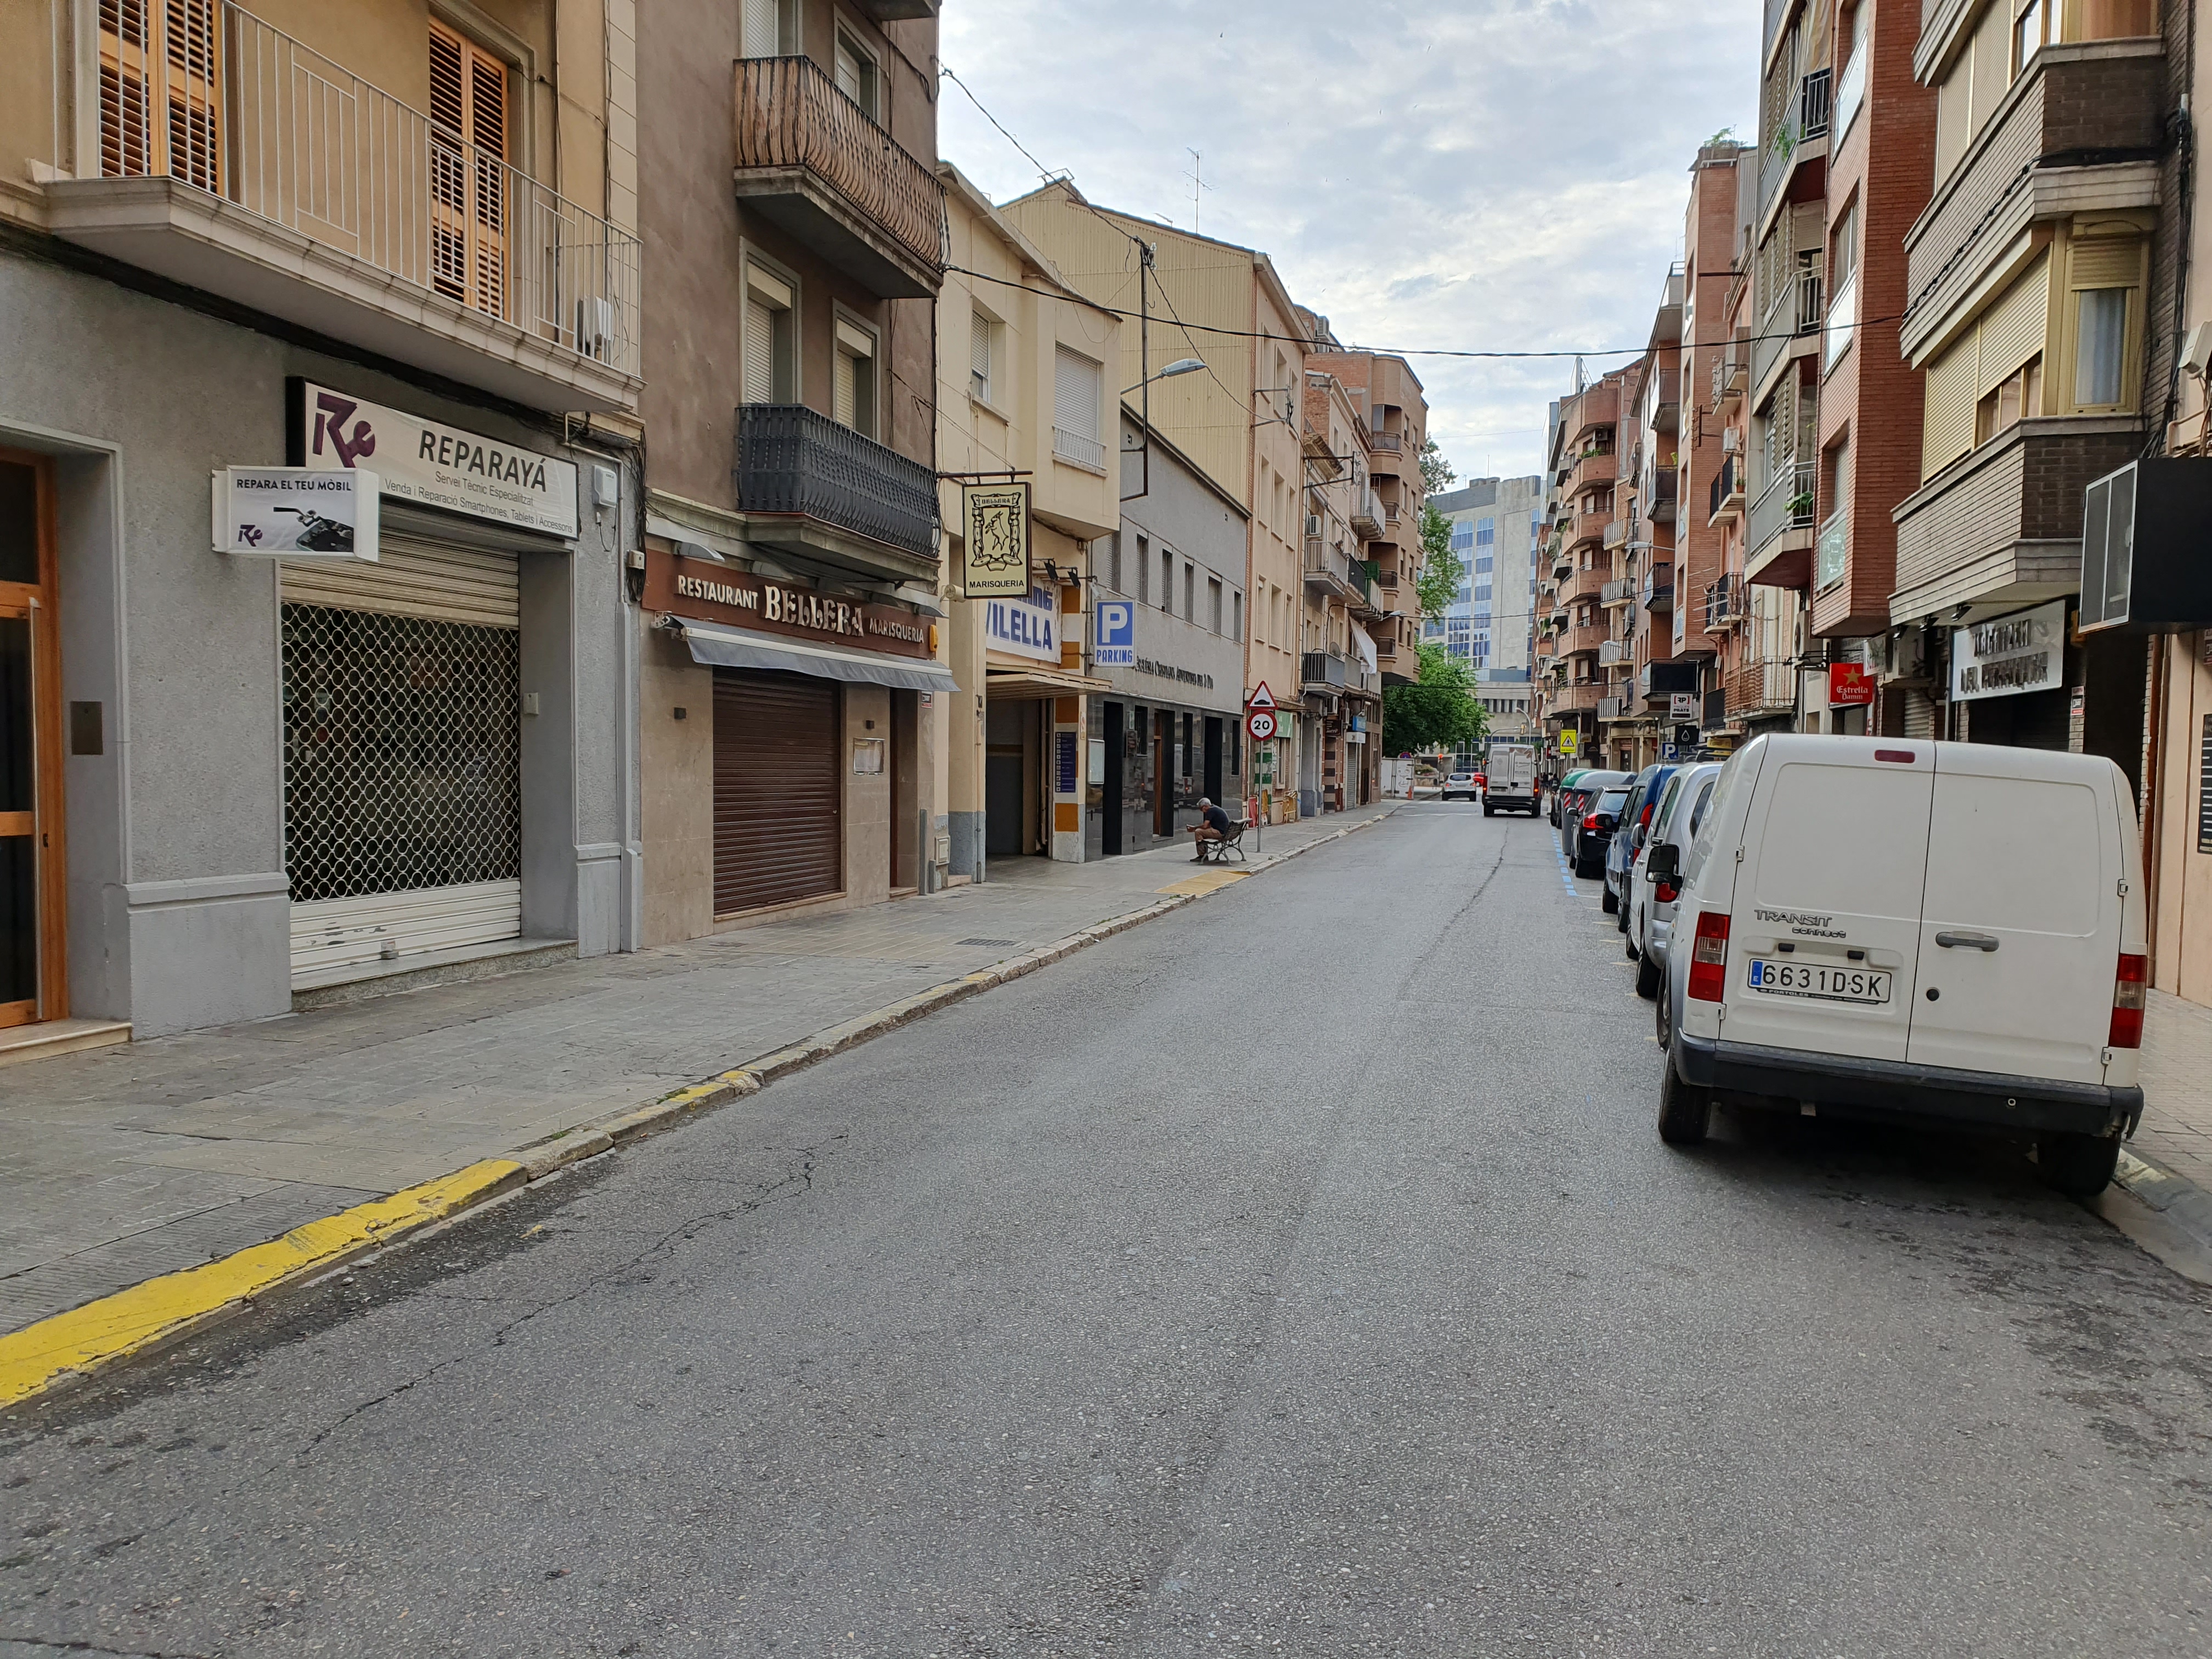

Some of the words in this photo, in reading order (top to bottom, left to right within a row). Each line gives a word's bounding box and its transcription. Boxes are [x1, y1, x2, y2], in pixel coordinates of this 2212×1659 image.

[419, 430, 546, 493] REPARAYÁ
[236, 479, 278, 489] REPARA
[281, 481, 293, 490] EL
[295, 481, 314, 490] TEU
[317, 479, 352, 491] MÒBIL
[435, 470, 461, 487] Servei
[462, 478, 487, 495] Tècnic
[489, 485, 534, 506] Especialitzat
[385, 478, 411, 494] Venda
[418, 486, 458, 506] Reparació
[459, 496, 509, 518] Smartphones,
[510, 509, 534, 524] Tablets
[539, 517, 573, 533] Accessoris
[969, 580, 1024, 589] MARISQUERIA
[678, 575, 758, 610] RESTAURANT
[764, 585, 865, 637] BELLERA
[868, 618, 924, 644] MARISQUERIA
[1097, 649, 1133, 663] PARKING
[1837, 685, 1868, 693] Estrella
[1254, 720, 1270, 730] 20
[1754, 910, 1832, 927] TRANSIT
[1792, 927, 1846, 938] connect
